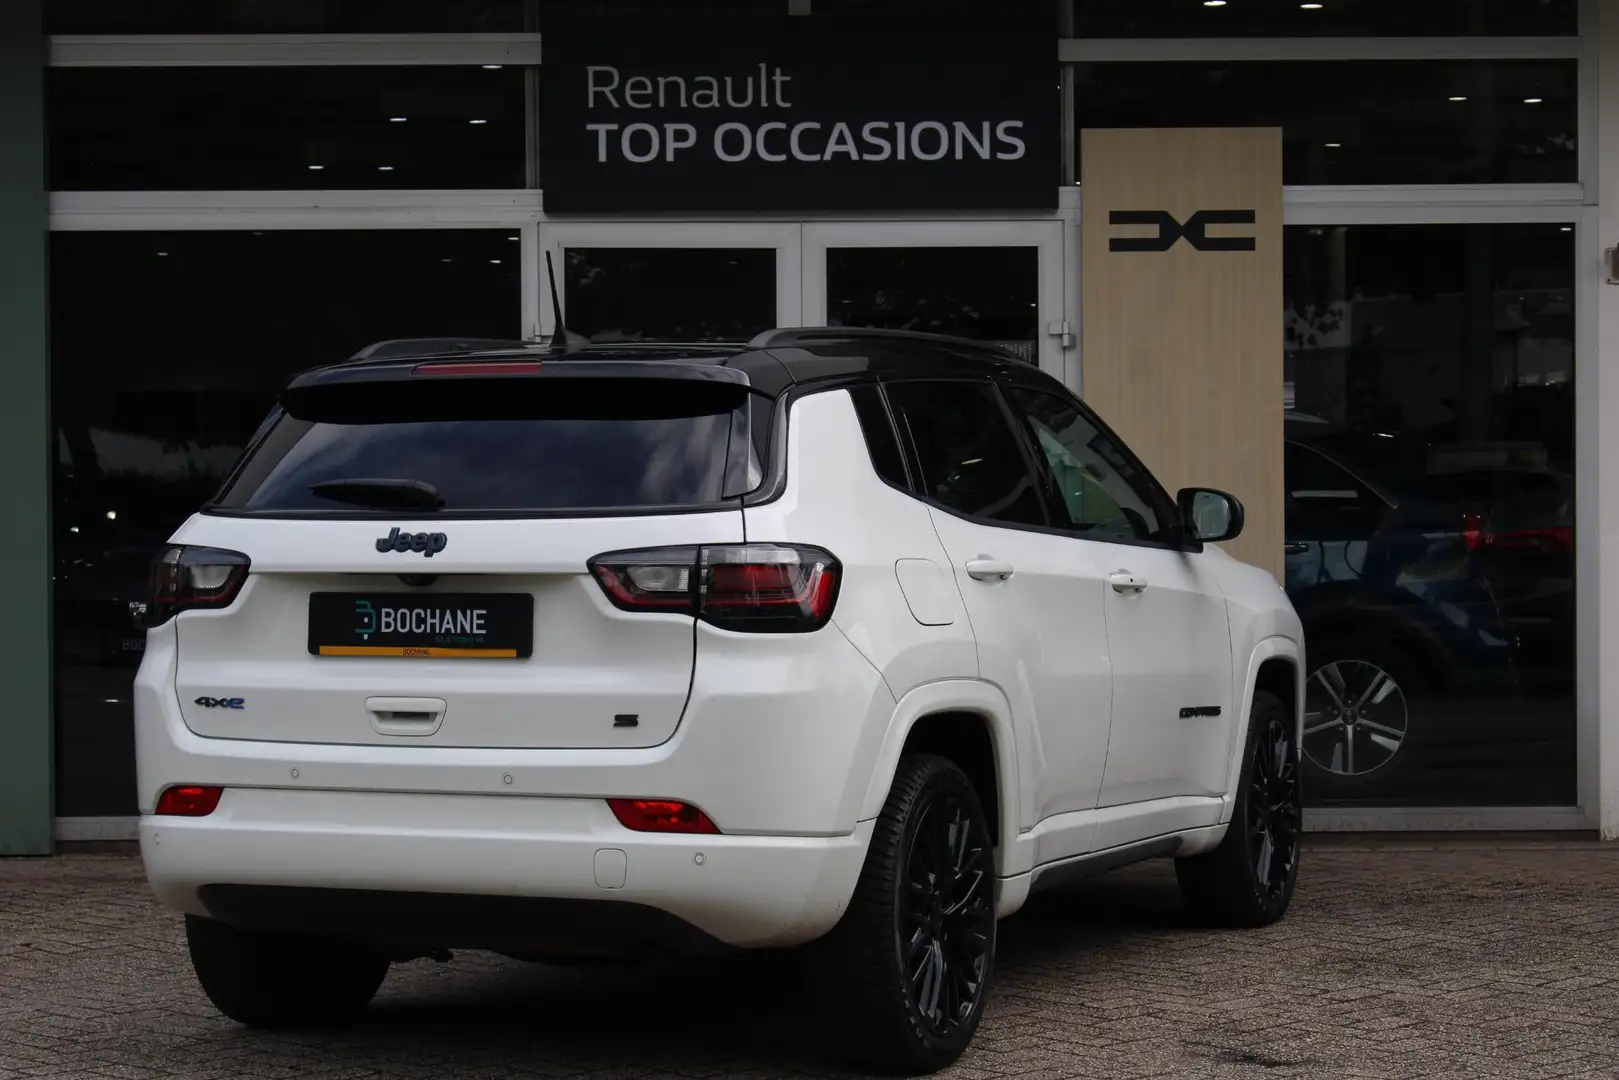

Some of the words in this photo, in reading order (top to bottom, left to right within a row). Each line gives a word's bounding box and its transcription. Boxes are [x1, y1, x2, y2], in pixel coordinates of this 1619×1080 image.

[587, 63, 792, 109] Renault
[585, 122, 697, 163] TOP
[713, 120, 1026, 163] OCCASIONS
[375, 527, 447, 558] Jeep
[381, 607, 487, 634] BOCHANE
